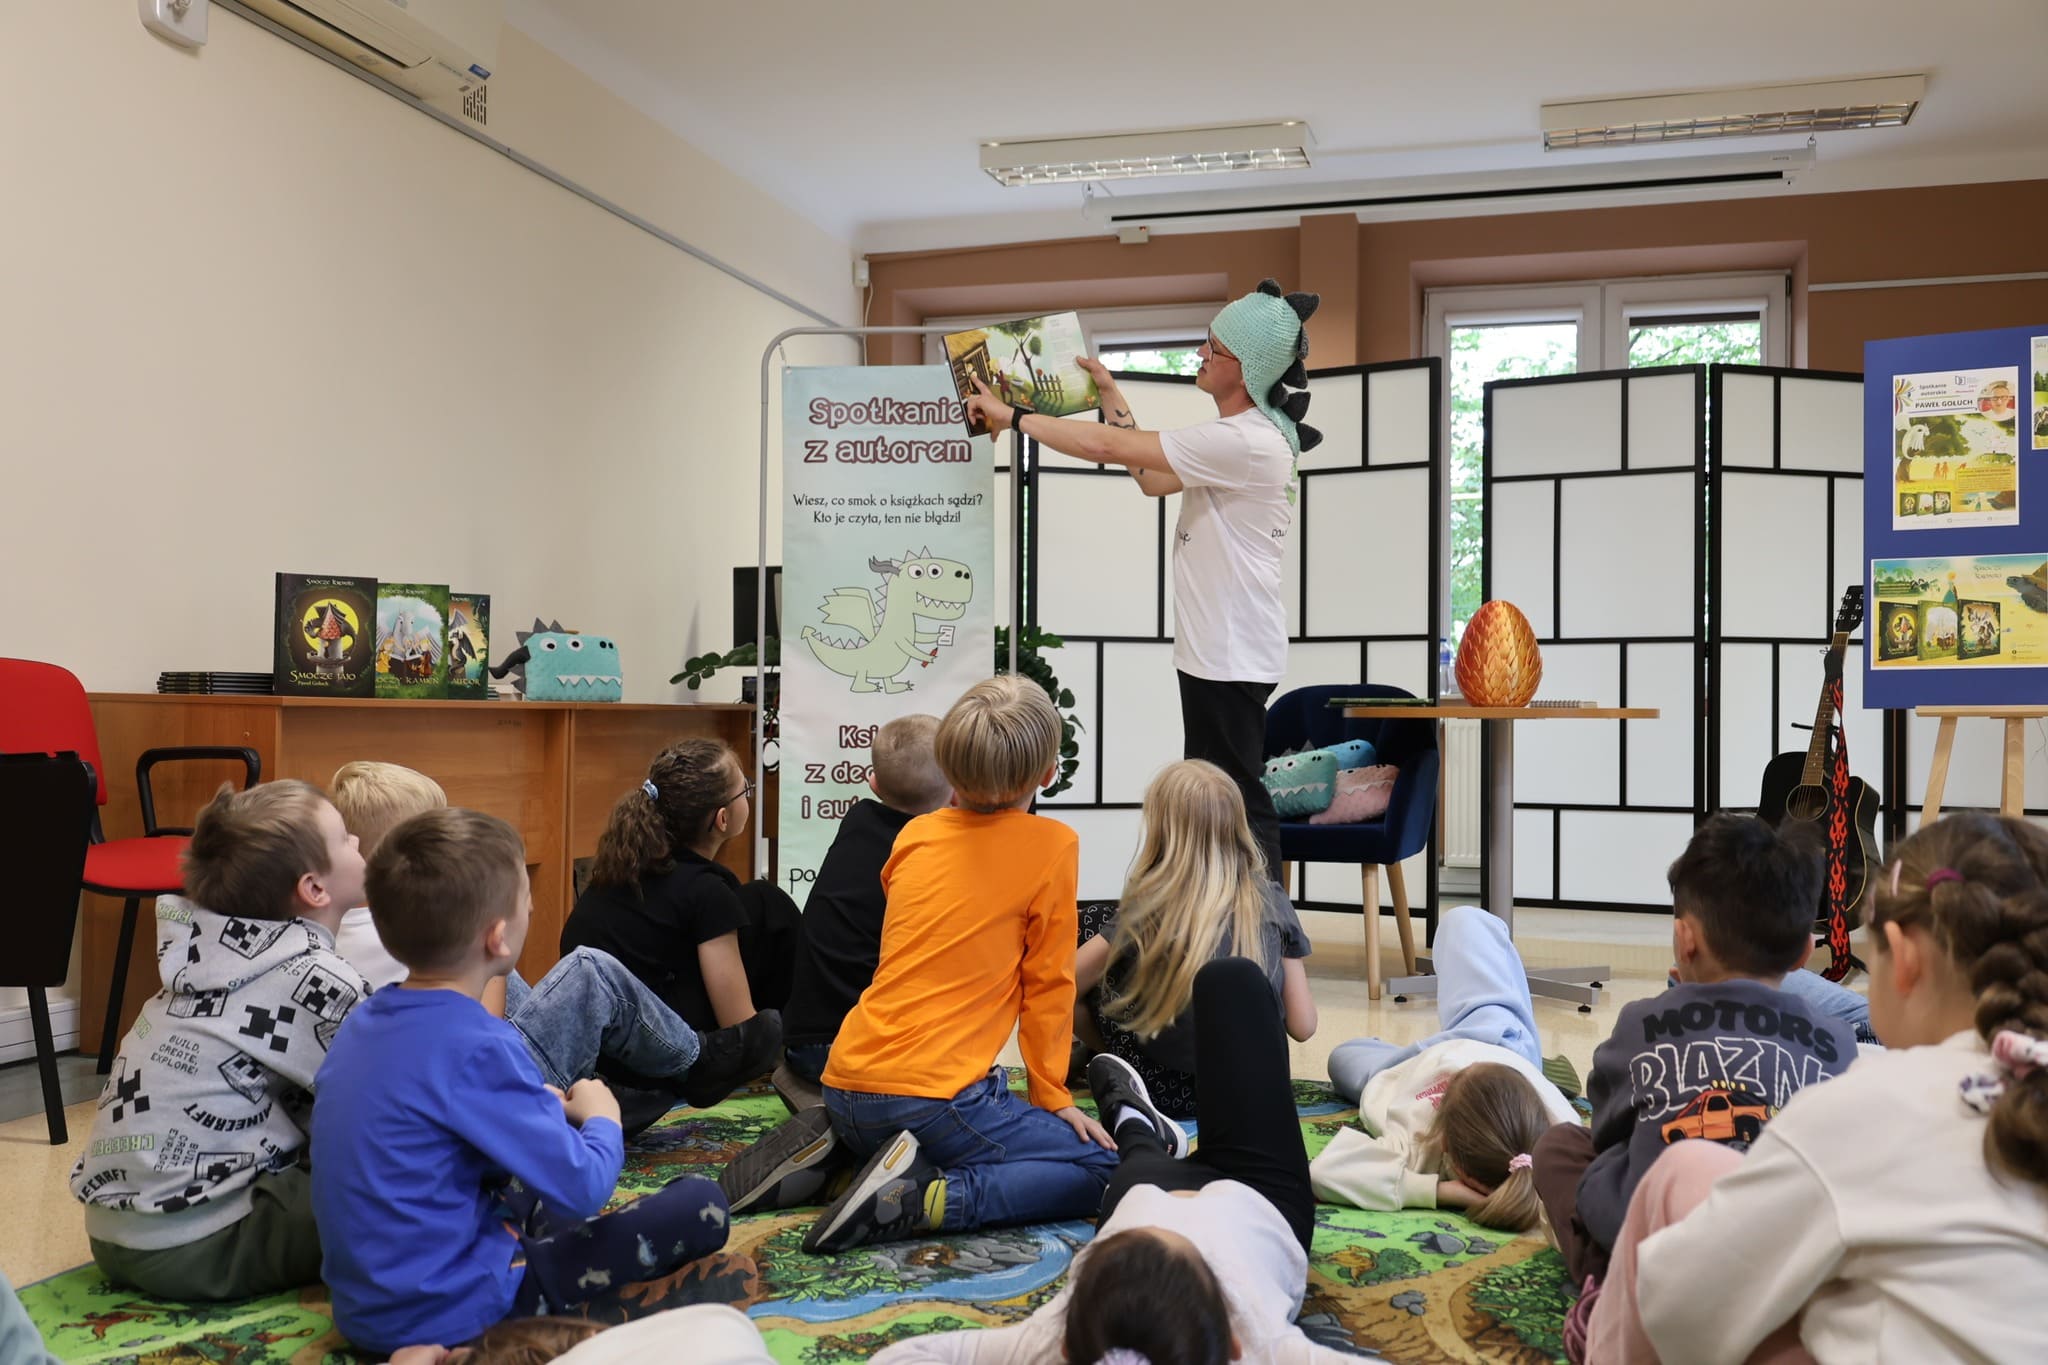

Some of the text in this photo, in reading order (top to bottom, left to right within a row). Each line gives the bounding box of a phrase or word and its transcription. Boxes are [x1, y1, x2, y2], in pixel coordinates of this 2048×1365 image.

[809, 397, 966, 429] Spotkanie
[804, 436, 972, 463] z autorem
[793, 493, 983, 508] Wiesz, co smok o książkach sądzi?
[813, 511, 832, 523] Kto
[834, 512, 845, 525] je
[848, 513, 881, 526] czyta,
[885, 513, 901, 523] ten
[905, 513, 921, 523] nie
[1643, 1001, 1838, 1063] MOTORS
[1629, 1037, 1833, 1122] BLAZIN
